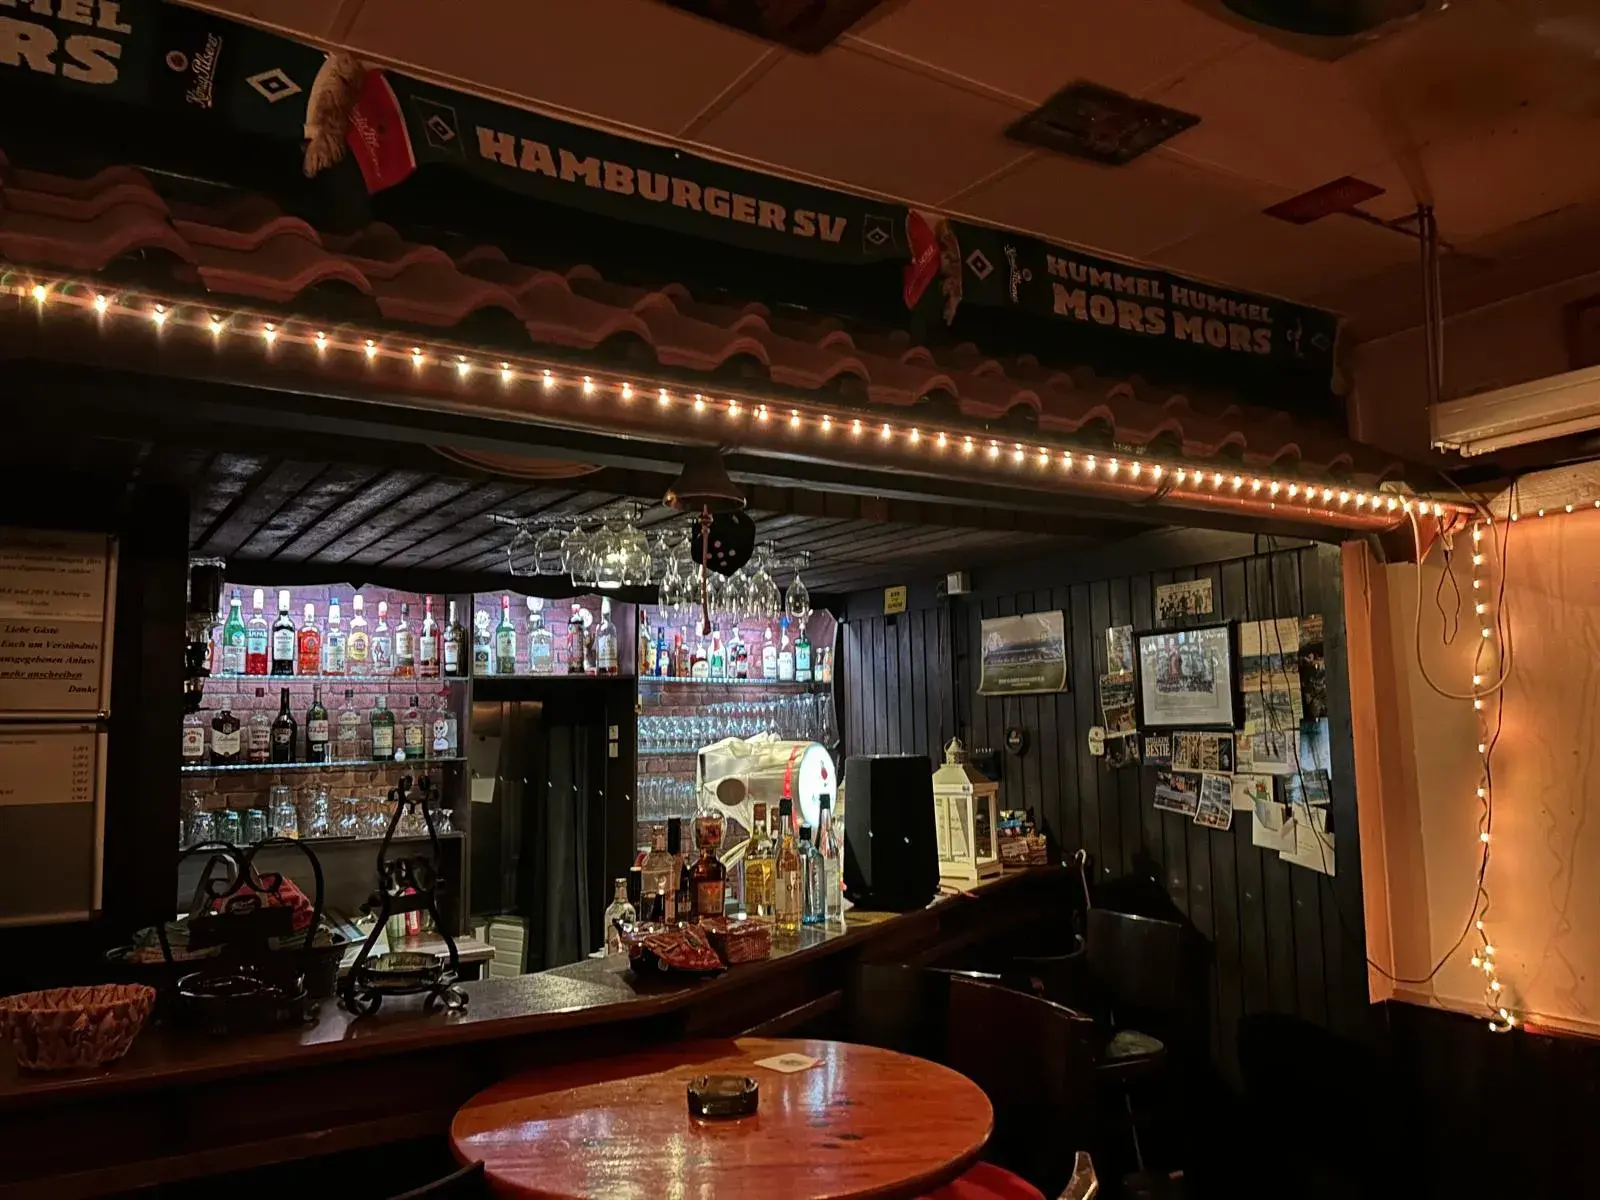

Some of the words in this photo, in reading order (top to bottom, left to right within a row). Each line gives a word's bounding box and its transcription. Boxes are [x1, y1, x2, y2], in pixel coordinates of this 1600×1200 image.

[475, 126, 786, 232] HAMBURGER
[792, 209, 847, 243] SV
[1046, 254, 1164, 300] HUMMEL
[1169, 284, 1272, 322] HUMMEL
[1052, 282, 1164, 336] MORS
[1171, 310, 1273, 354] MORS
[5, 625, 31, 634] Liebe
[1, 640, 25, 648] Euch
[46, 641, 98, 650] Verständnis
[65, 656, 96, 664] Anlass
[1, 670, 26, 679] mehr
[27, 670, 83, 680] anschreiben
[68, 685, 98, 693] Danke
